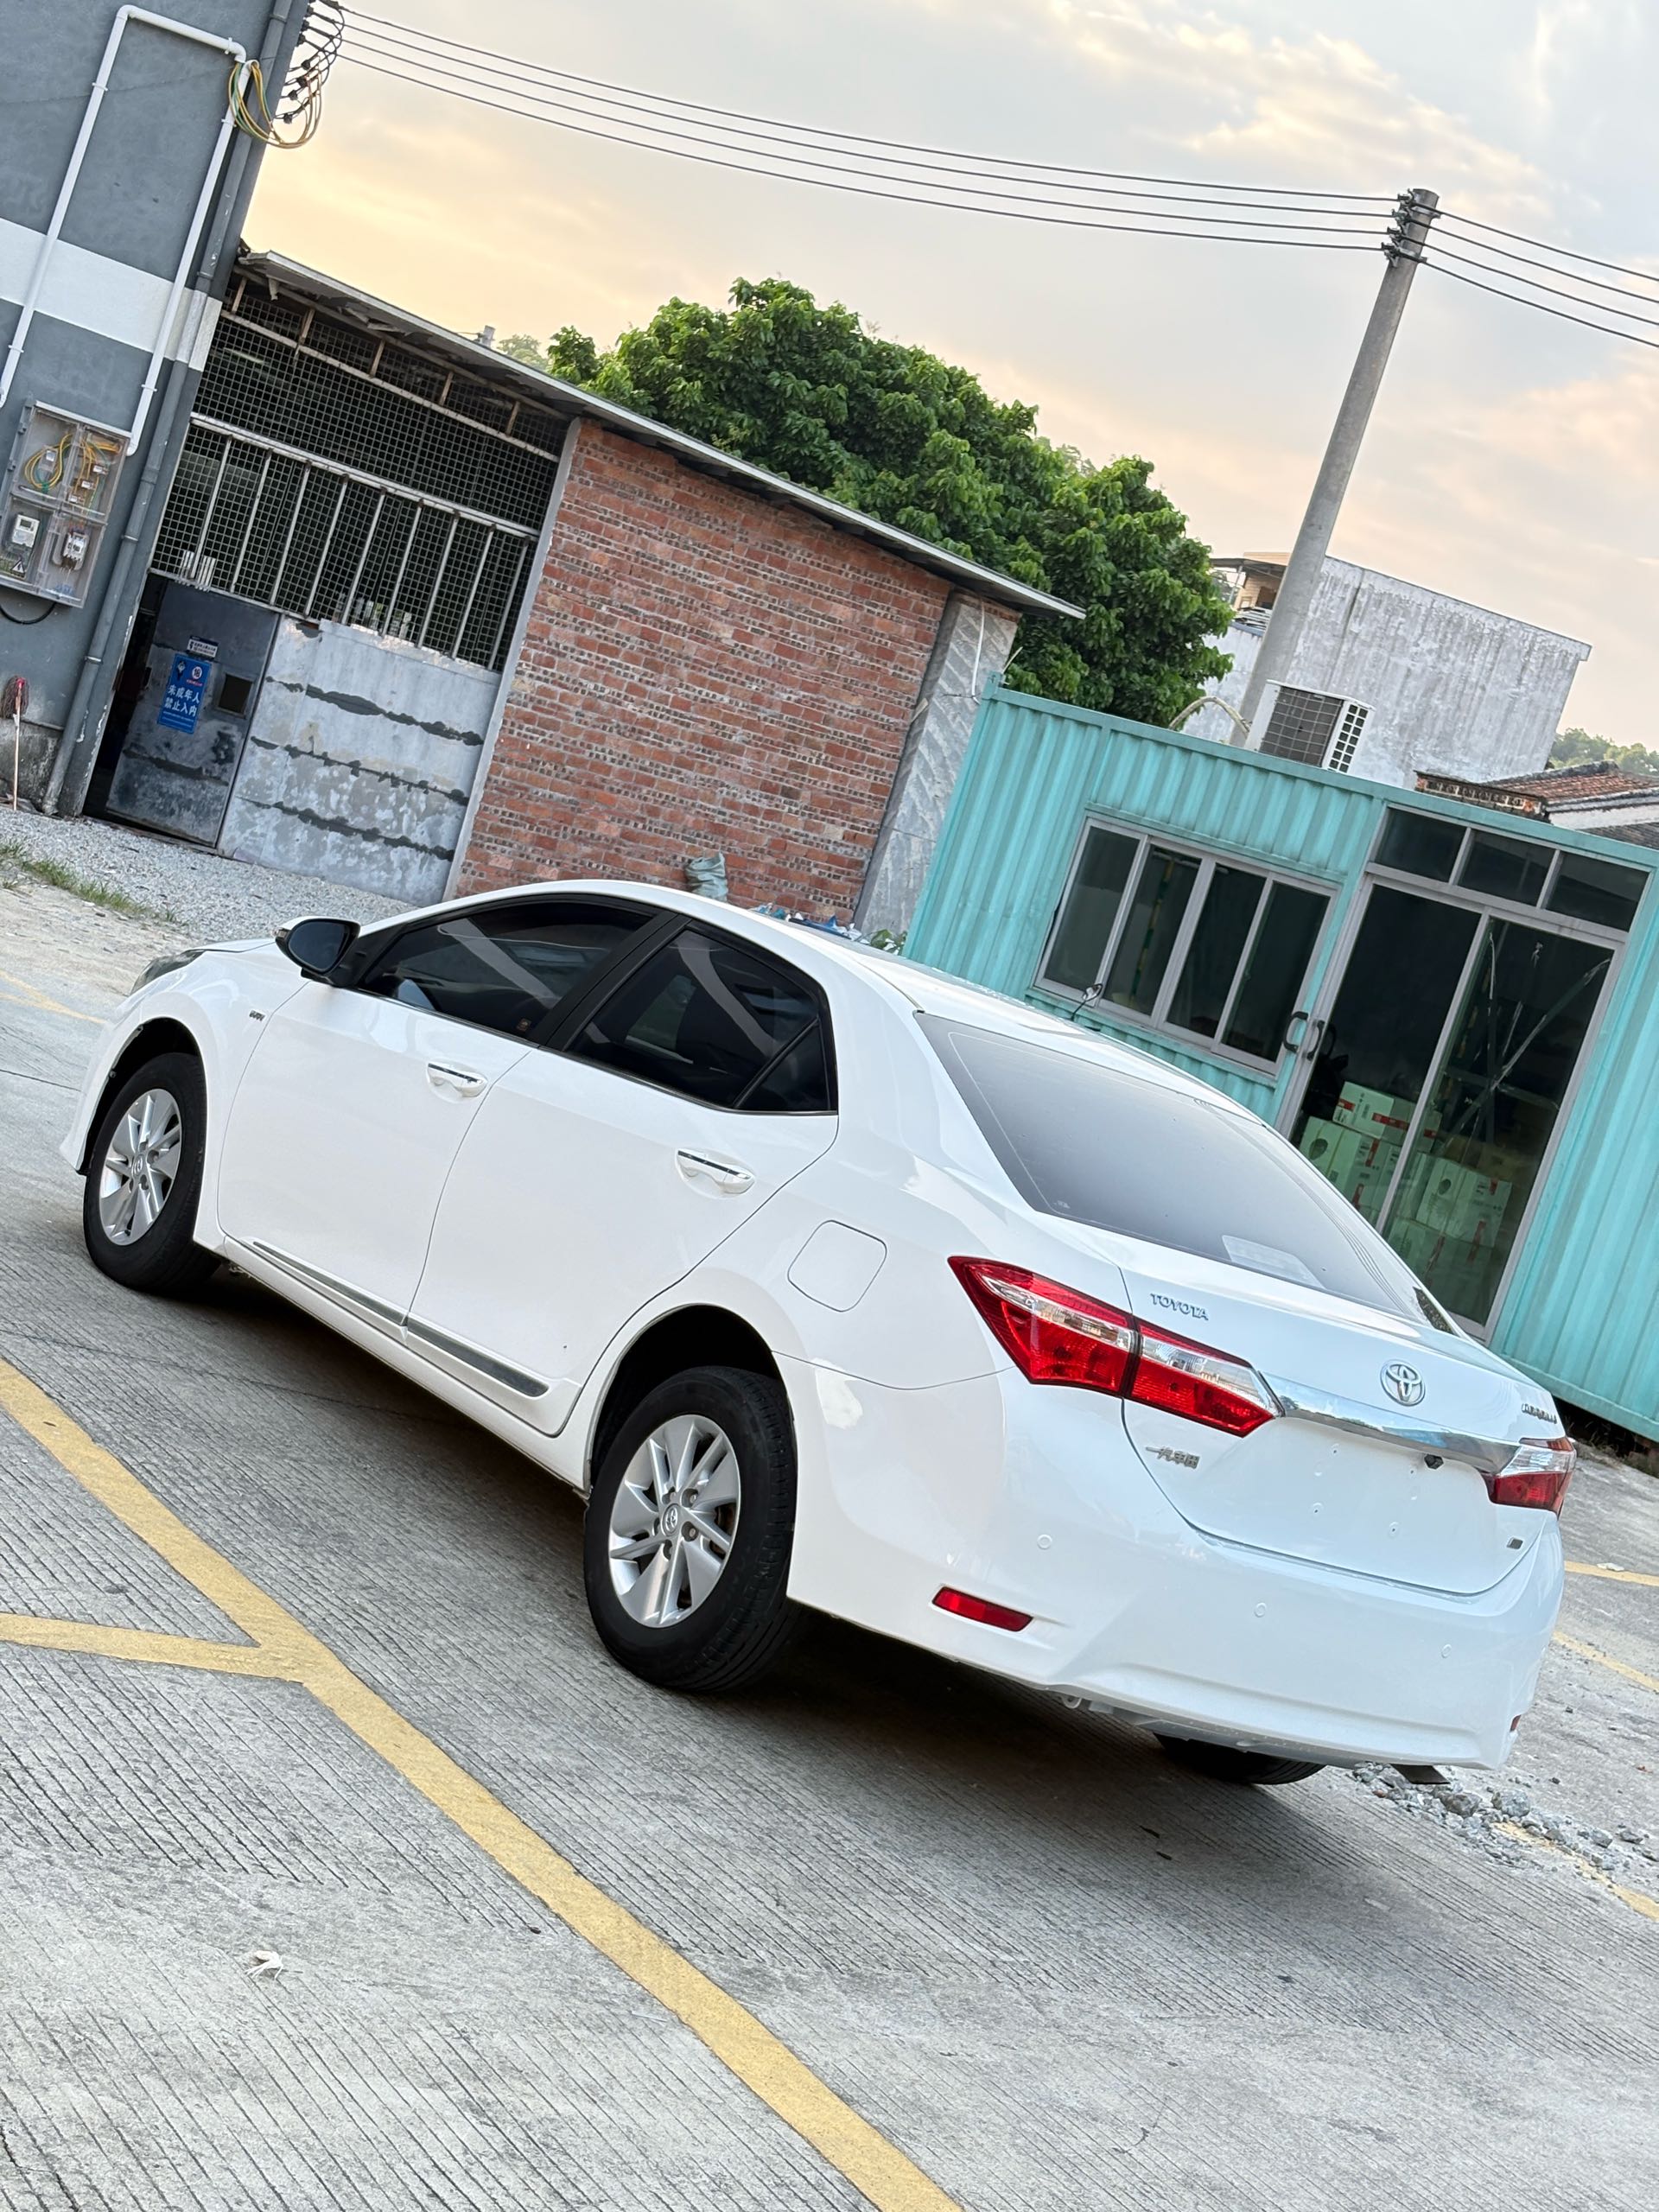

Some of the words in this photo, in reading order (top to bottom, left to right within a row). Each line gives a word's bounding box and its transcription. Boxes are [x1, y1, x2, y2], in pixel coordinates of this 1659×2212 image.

[168, 684, 200, 704] 未成年人
[164, 696, 197, 717] 禁止入内
[1150, 1293, 1209, 1320] TOYOTA
